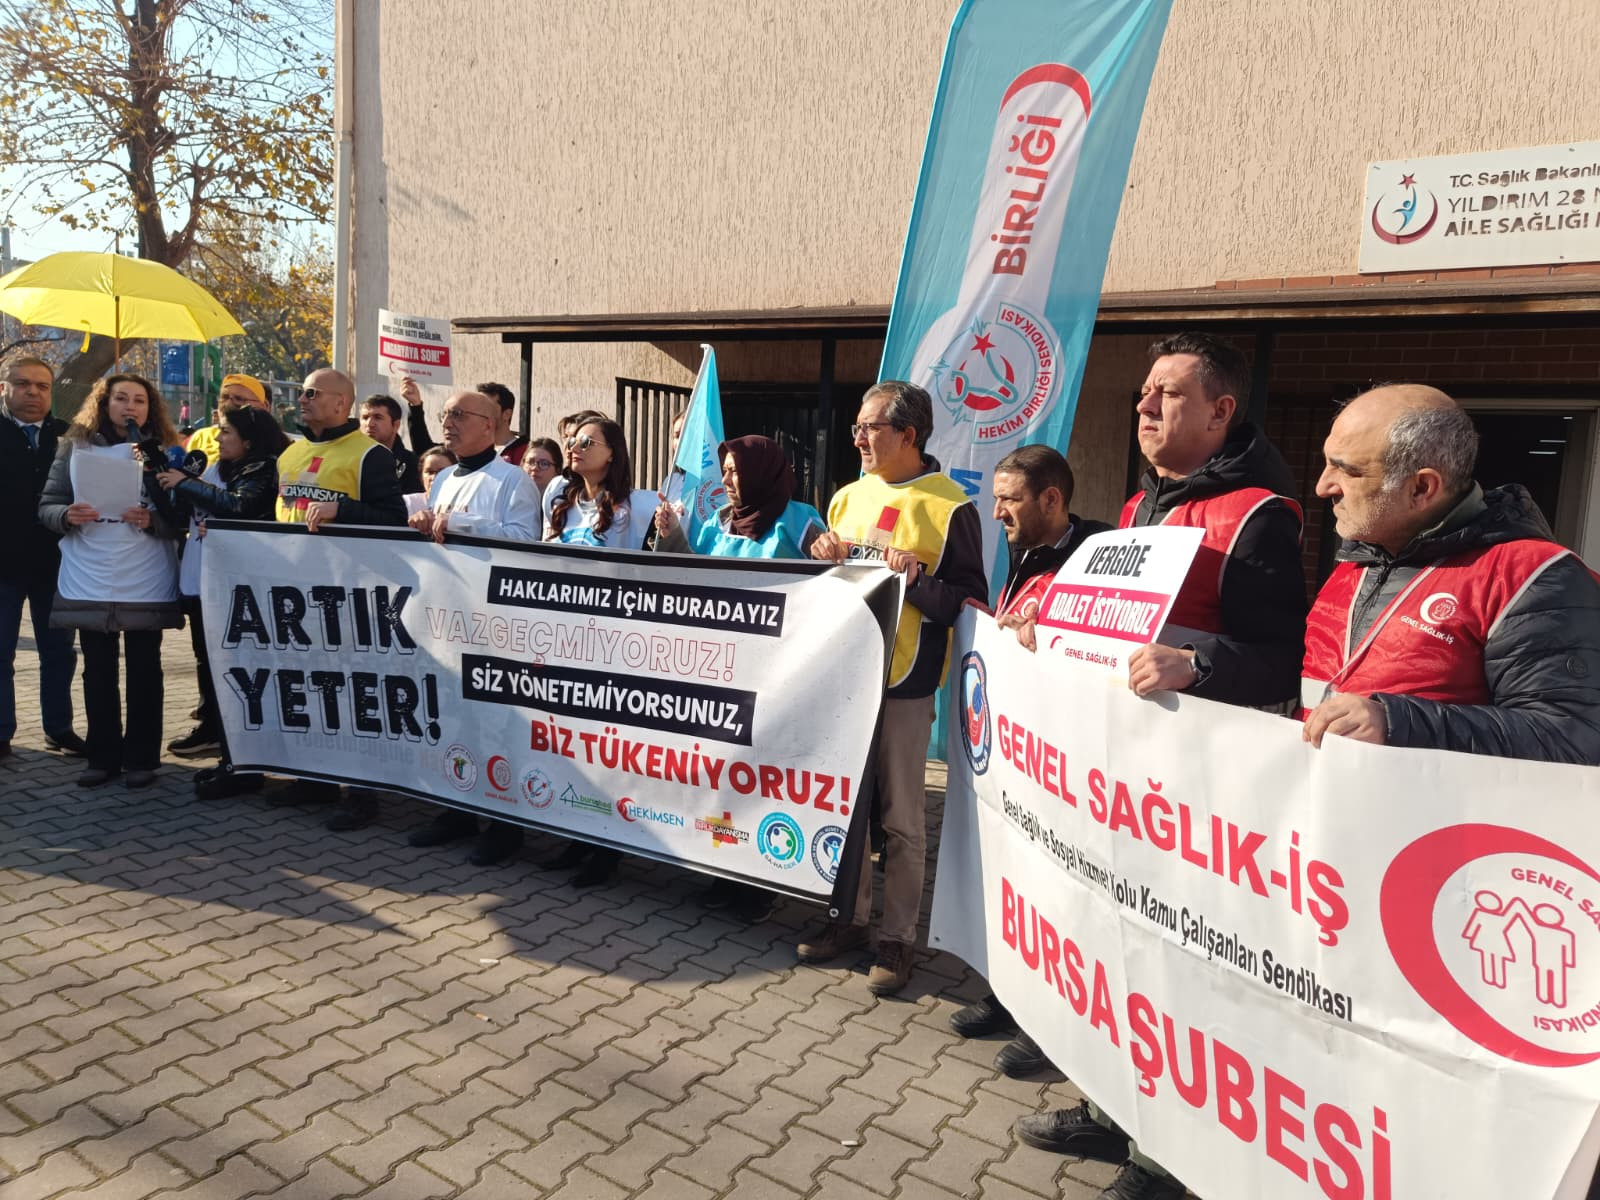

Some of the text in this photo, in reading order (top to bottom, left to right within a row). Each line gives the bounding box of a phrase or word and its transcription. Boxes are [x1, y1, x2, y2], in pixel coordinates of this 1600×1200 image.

[991, 114, 1062, 276] BİRLİĞİ
[1448, 190, 1549, 214] YILDIRIM
[1556, 189, 1585, 206] 28
[1449, 174, 1474, 188] T.C.
[1478, 168, 1530, 187] Sağlık
[1444, 217, 1491, 236] AİLE
[1497, 209, 1589, 233] SAĞLIĞI
[979, 309, 1052, 438] HEKİM BİRLİĞİ SENDİKASI
[1084, 539, 1152, 577] VERGİDE
[222, 584, 417, 655] ARTIK
[499, 578, 780, 627] HAKLARIMIZ İÇİN BURADAYIZ
[1046, 590, 1160, 636] ADALET İSTİYORUZ
[1400, 615, 1455, 645] GENEL SAĞLIK-İŞ
[425, 607, 736, 682] VAZGEÇMİYORUZ!
[1064, 647, 1118, 668] GENEL SAĞLIK-İŞ
[223, 667, 441, 746] YETER!
[471, 665, 744, 736] SİZ YÖNETEMİYORSUNUZ,
[531, 715, 851, 817] BİZ TÜKENİYORUZ!
[628, 805, 685, 827] HEKİMSEN
[997, 714, 1349, 947] GENEL SAĞLIK-İŞ
[1002, 790, 1019, 824] Genel
[1019, 801, 1041, 842] Sağlık
[1041, 825, 1050, 849] ve
[1049, 828, 1077, 871] Sosyal
[1077, 847, 1110, 893] Hizmet
[1140, 885, 1177, 932] Kamu
[1181, 906, 1258, 976] Çalışanları
[1262, 949, 1352, 1022] Sendikası
[1511, 868, 1574, 901] GENEL
[1002, 876, 1391, 1200] BURSA ŞUBESİ
